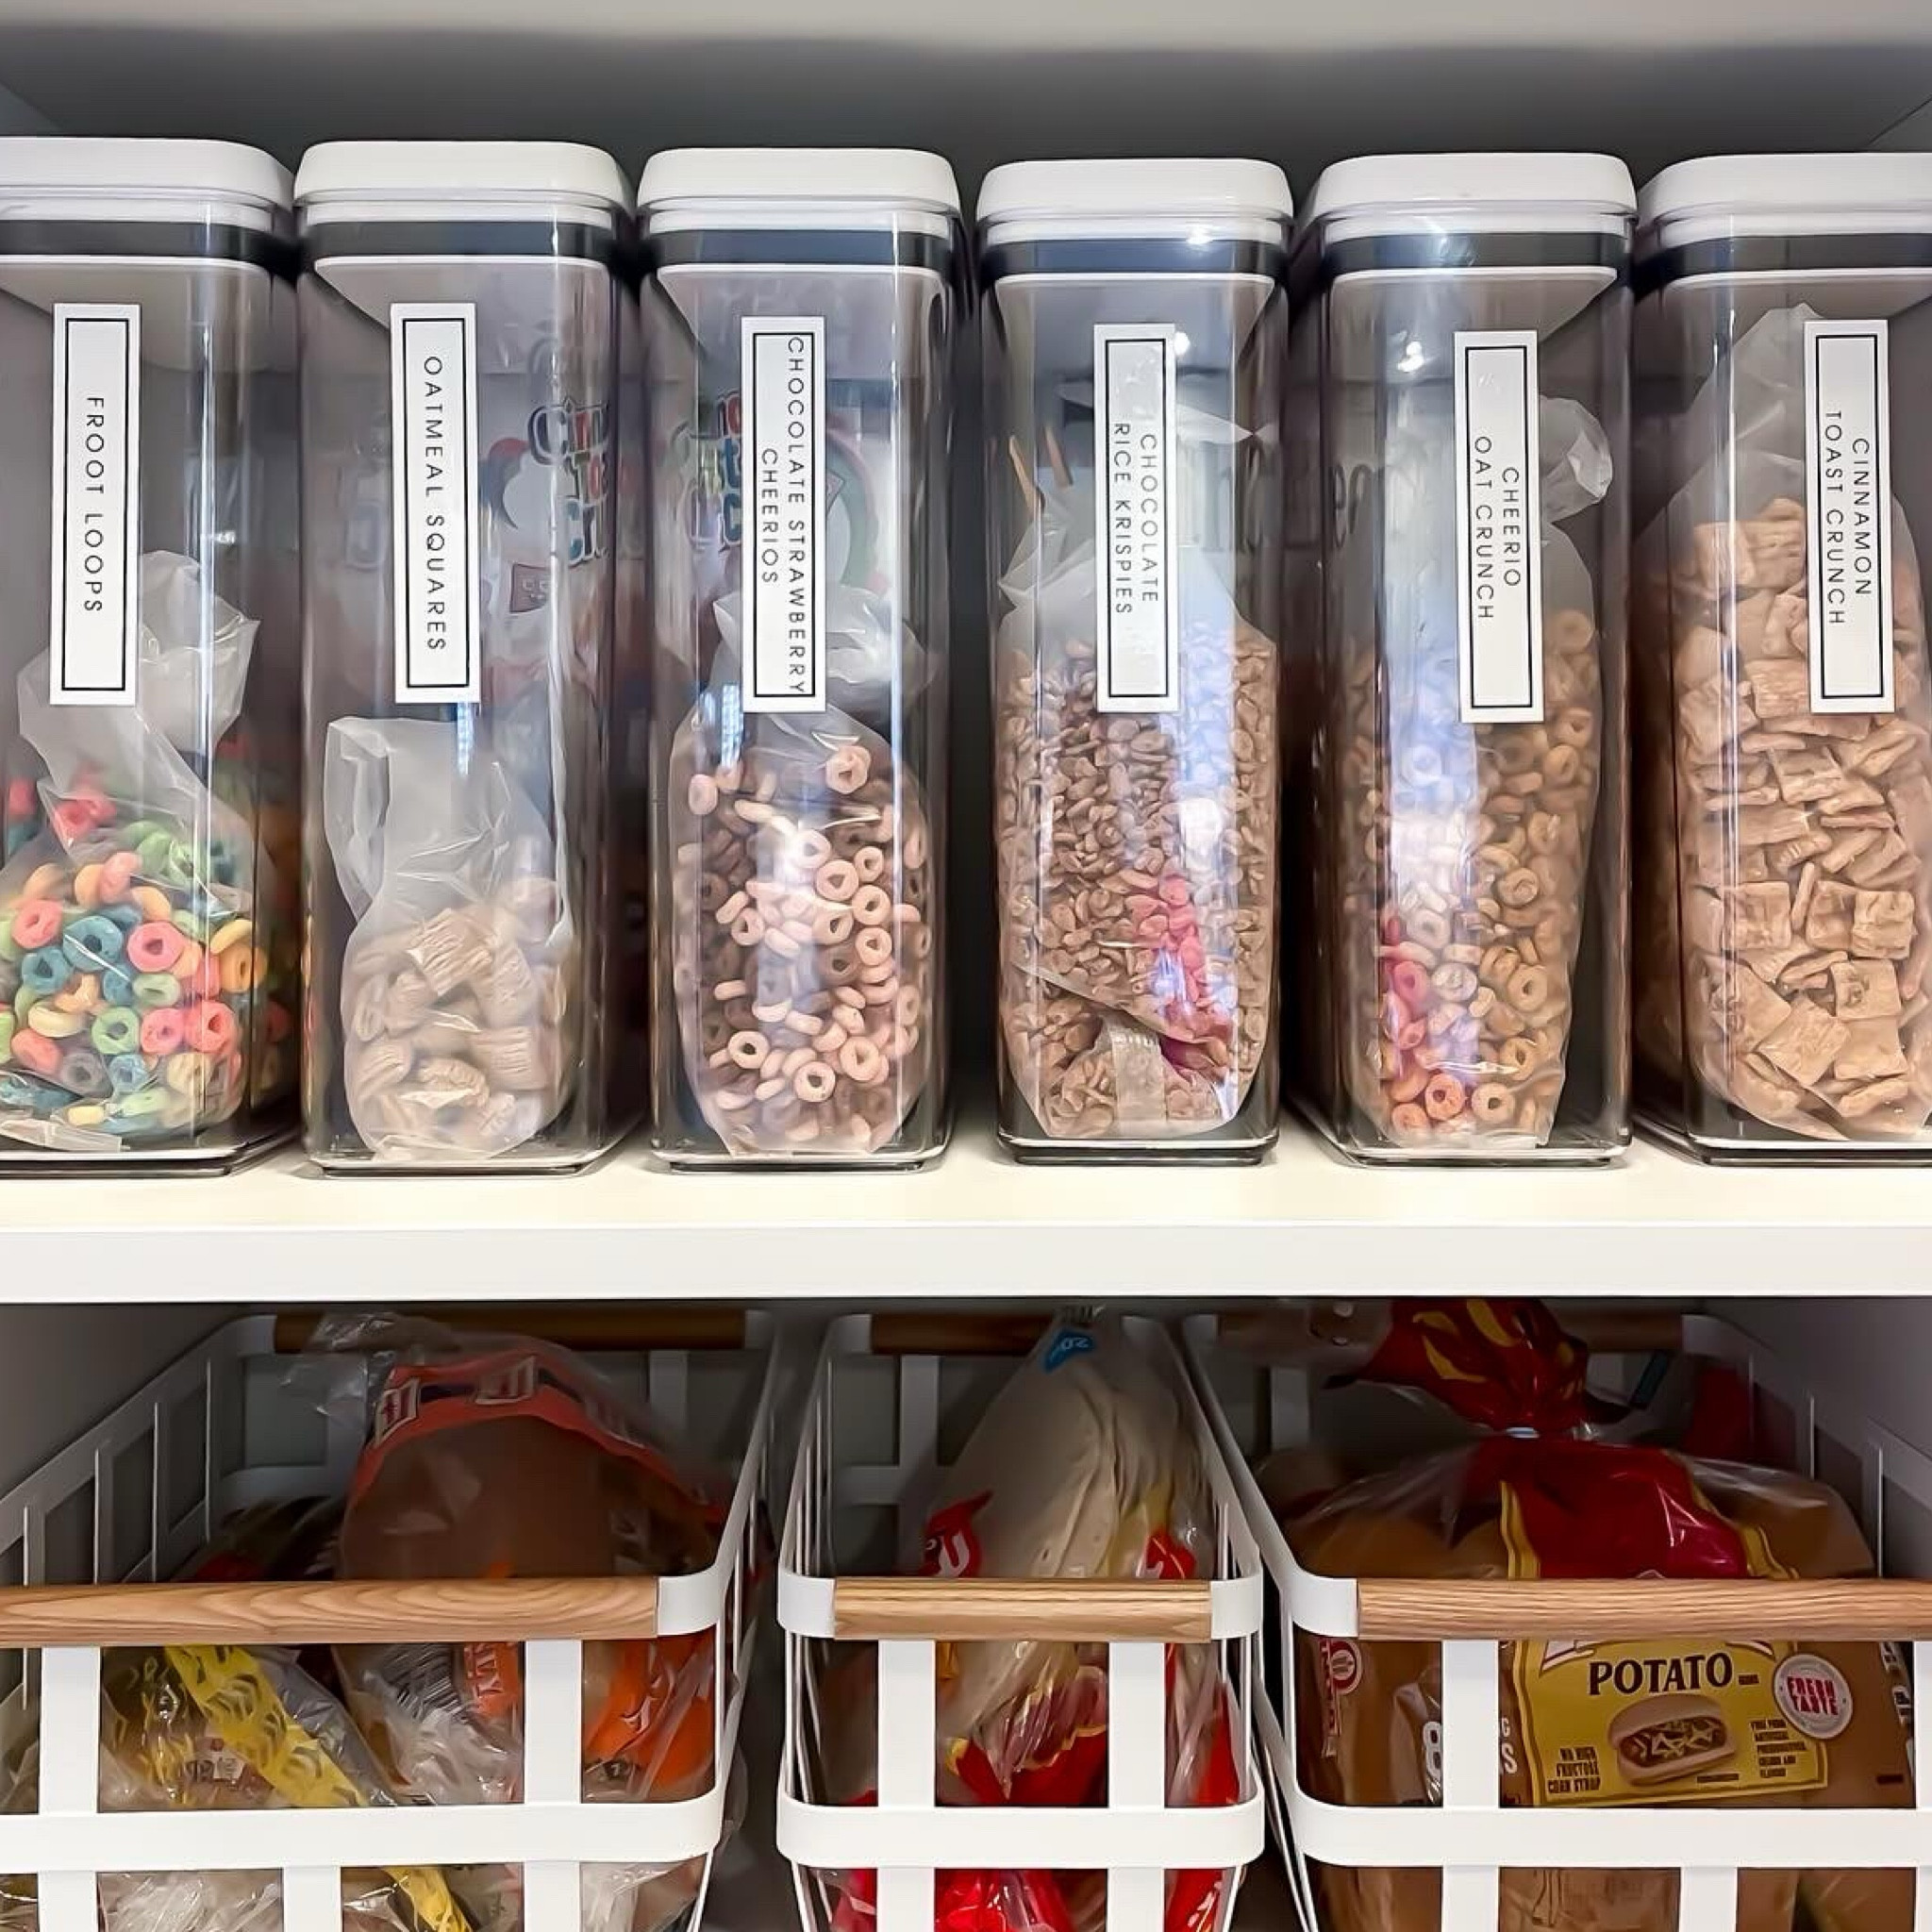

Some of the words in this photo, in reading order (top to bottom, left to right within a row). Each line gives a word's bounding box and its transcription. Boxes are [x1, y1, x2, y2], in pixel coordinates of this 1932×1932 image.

[85, 397, 105, 494] FROOT
[424, 356, 443, 496] OATMEAL
[788, 336, 805, 503] CHOCOLATE
[1114, 423, 1131, 482] RICE
[1474, 436, 1492, 490] OAT
[1824, 410, 1843, 492] TOAST
[84, 513, 104, 611] LOOPS
[761, 448, 778, 583] CHEERIOS
[1115, 500, 1132, 614] KRISPIES
[1141, 434, 1158, 602] CHOCOLATE
[1475, 506, 1494, 621] CRUNCH
[1502, 467, 1521, 587] CHEERIO
[1825, 509, 1845, 625] CRUNCH
[1852, 438, 1872, 595] CINNAMON
[426, 514, 445, 650] SQUARES
[789, 520, 806, 693] STRAWBERRY
[1589, 1652, 1733, 1695] POTATO
[1787, 1675, 1835, 1698] FRESH
[1793, 1695, 1839, 1716] TASTE
